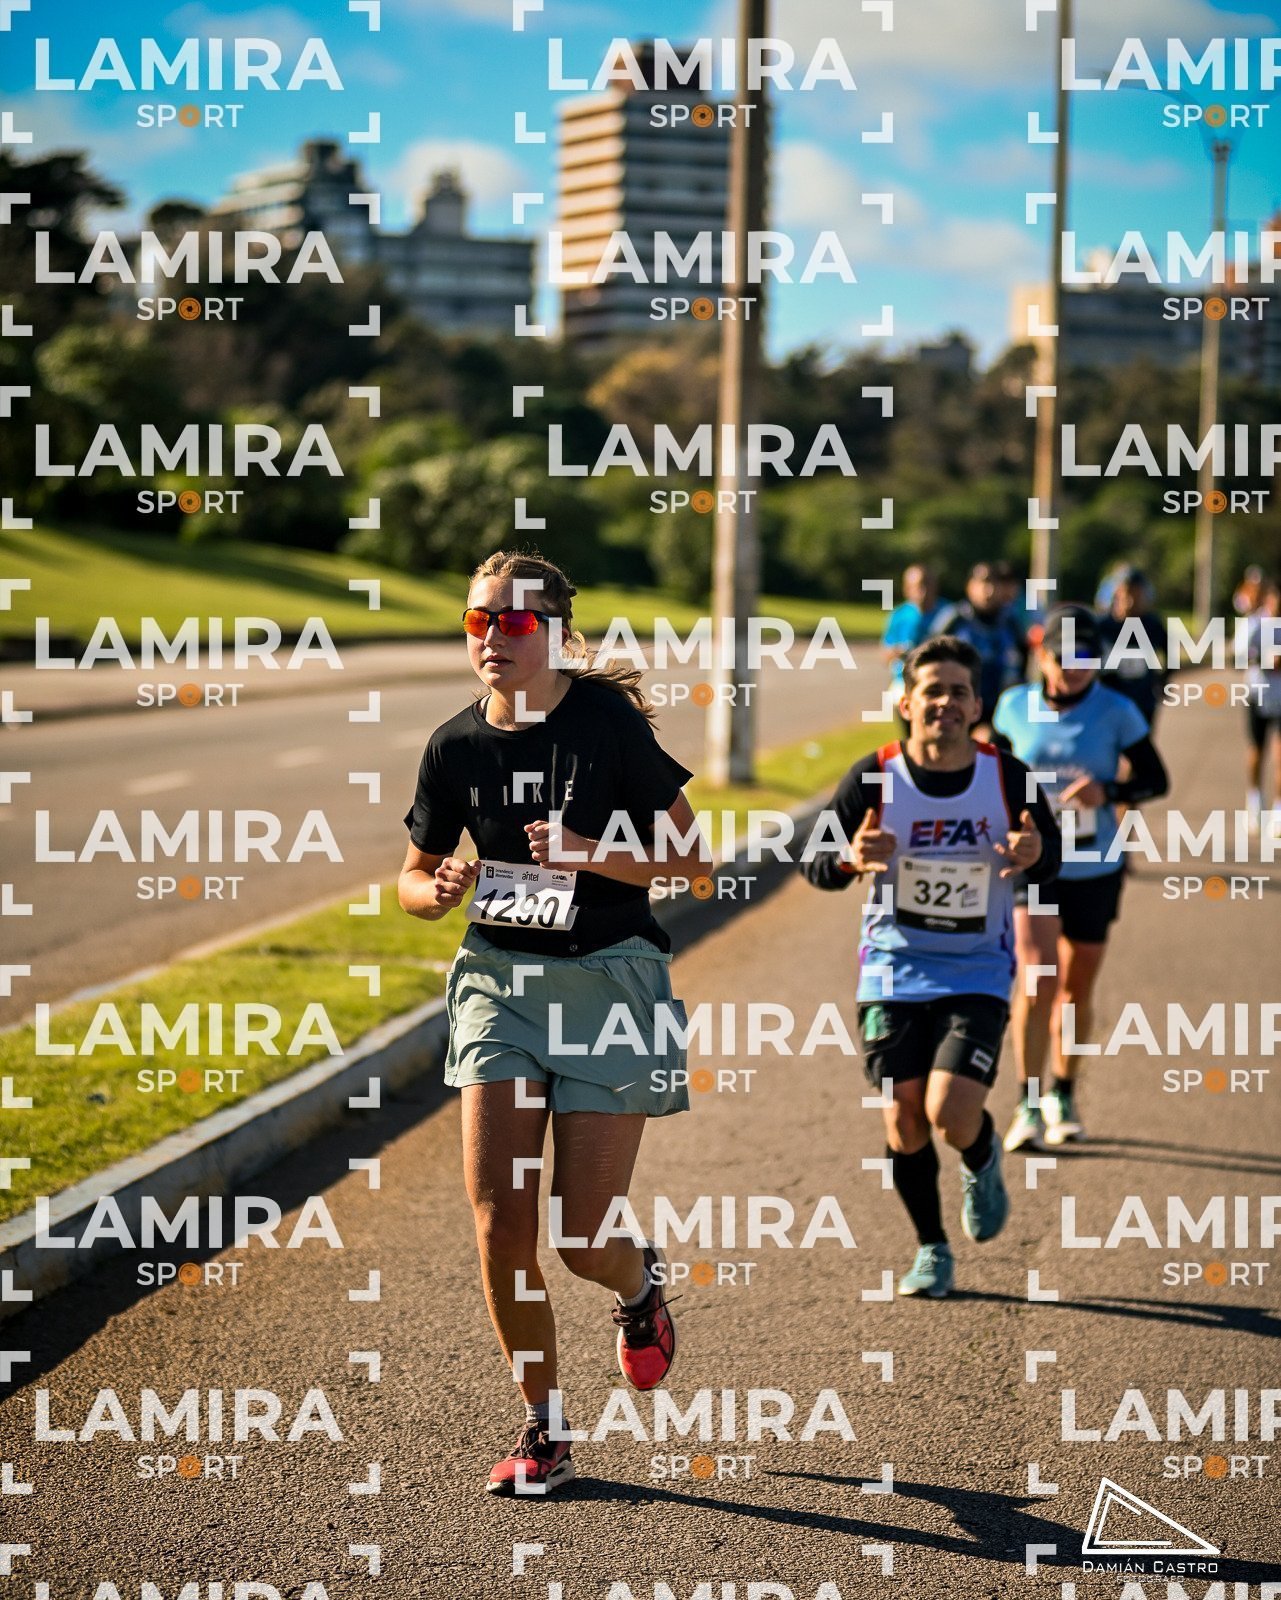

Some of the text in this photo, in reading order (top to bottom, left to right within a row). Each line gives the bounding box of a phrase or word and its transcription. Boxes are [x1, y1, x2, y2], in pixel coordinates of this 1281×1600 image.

[470, 780, 573, 807] NIKE
[909, 818, 977, 848] EFA
[480, 888, 560, 928] 1290
